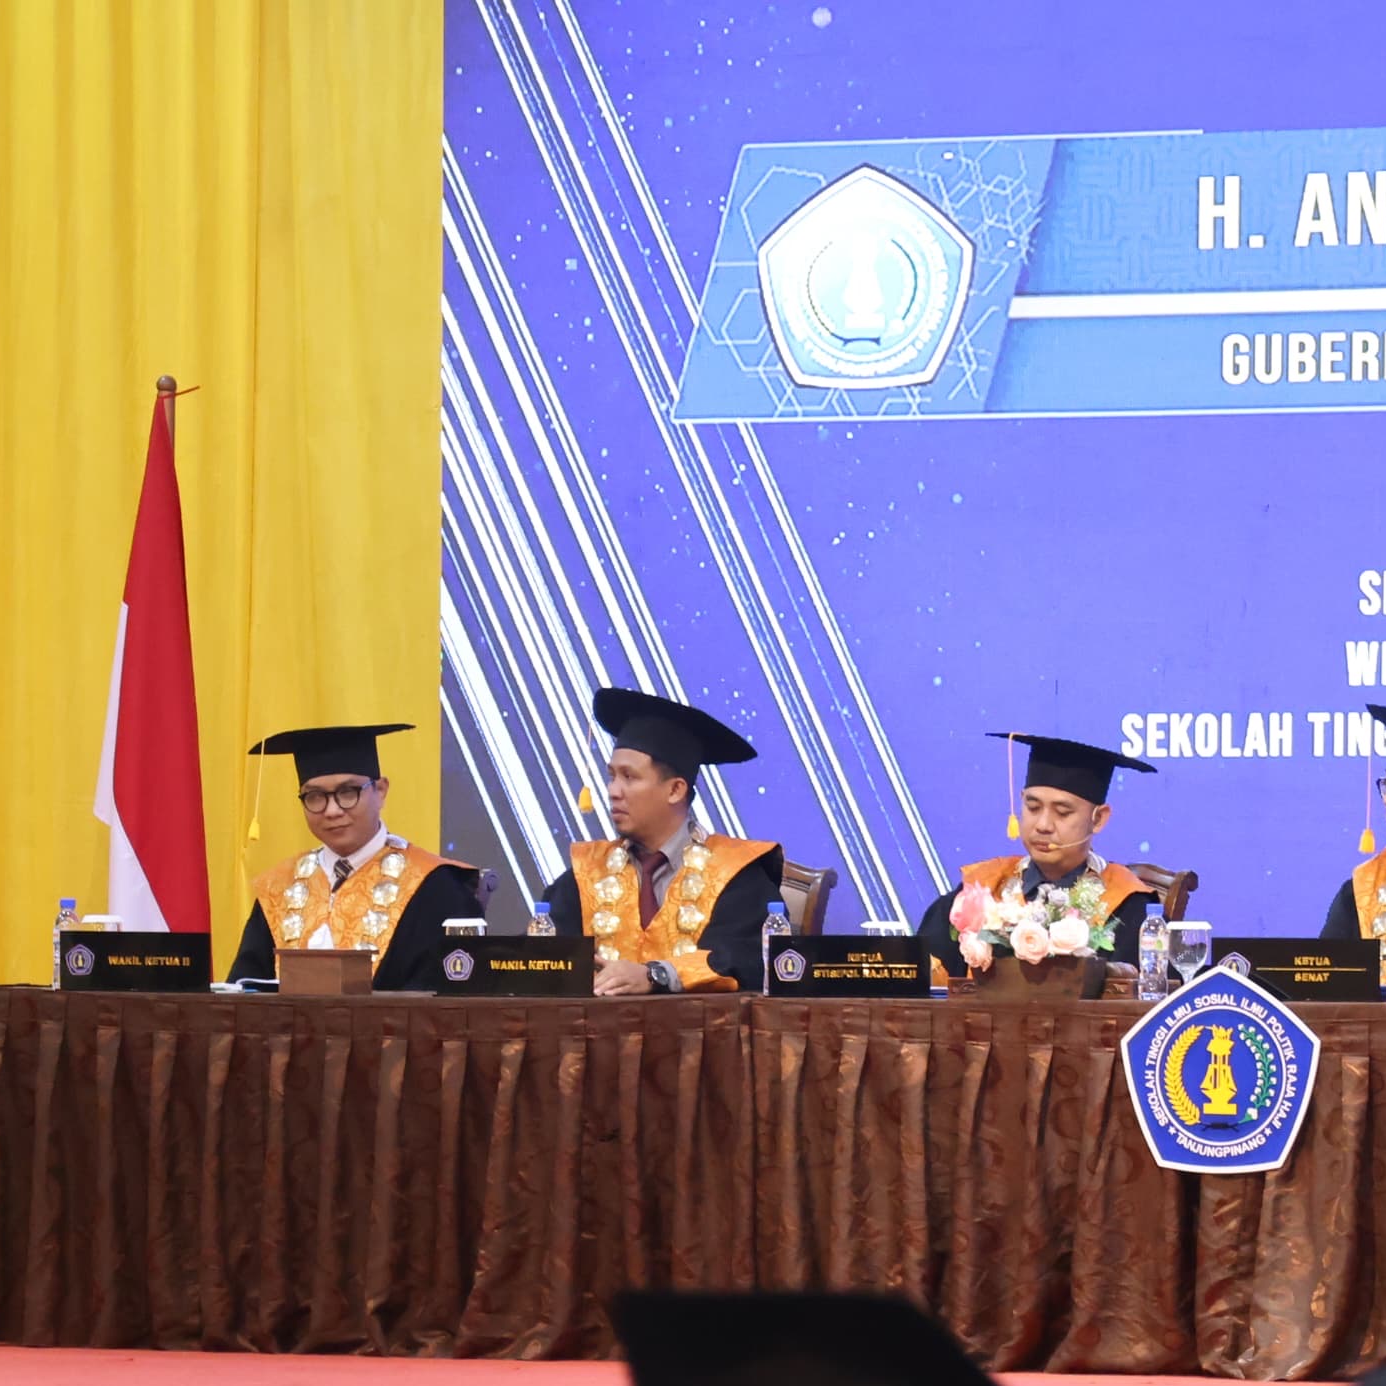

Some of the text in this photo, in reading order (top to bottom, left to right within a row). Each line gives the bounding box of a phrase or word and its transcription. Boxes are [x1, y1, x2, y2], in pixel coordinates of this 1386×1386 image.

[1197, 174, 1267, 250] H.
[1120, 711, 1294, 758] SEKOLAH
[108, 955, 142, 966] WAKIL
[144, 956, 180, 967] KETUA
[847, 952, 884, 963] KETUA
[1294, 956, 1331, 966] KETUA
[490, 959, 527, 970] WAKIL
[528, 959, 566, 970] KETUA
[862, 968, 890, 979] RAJA
[1294, 972, 1330, 982] SENAT
[1144, 993, 1298, 1129] SEKOLAH TINGGI ILMU SOSIAL ILMU POLITIK RAJA HAJI
[1175, 1133, 1267, 1158] TANJUNGPINANG
